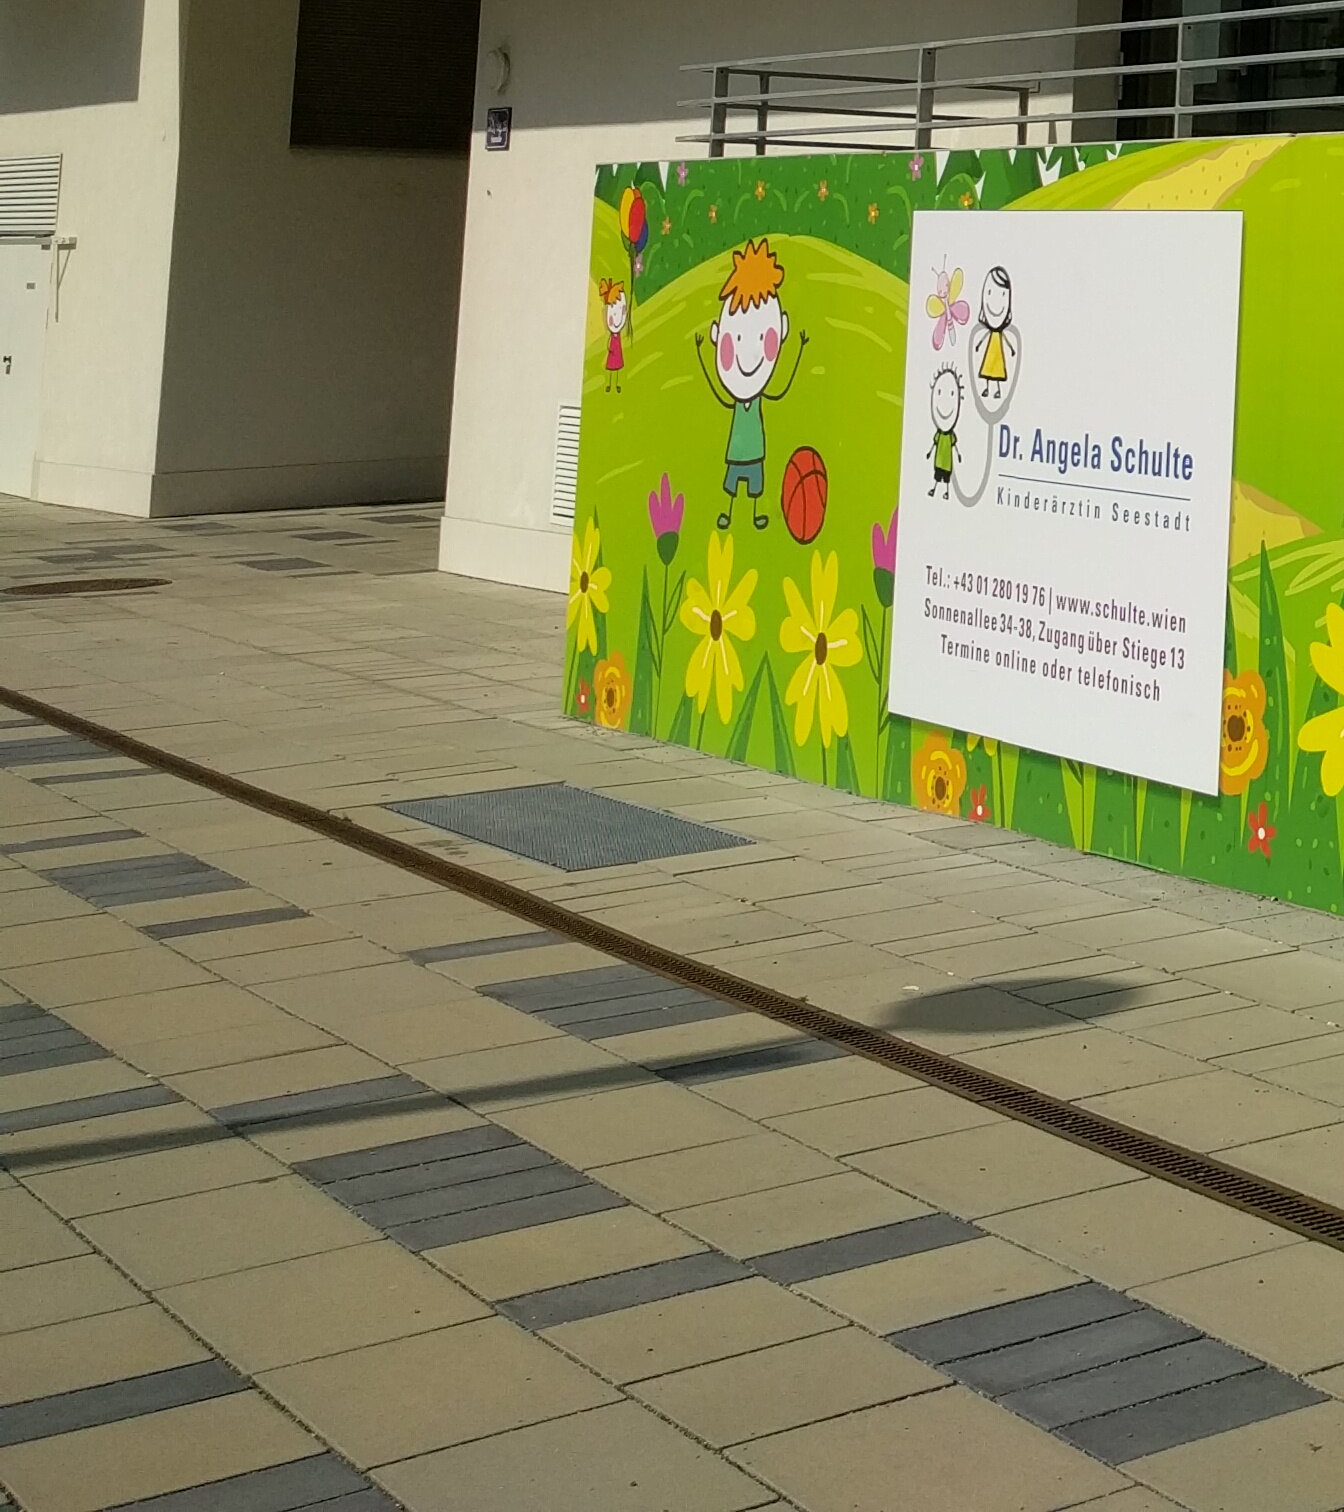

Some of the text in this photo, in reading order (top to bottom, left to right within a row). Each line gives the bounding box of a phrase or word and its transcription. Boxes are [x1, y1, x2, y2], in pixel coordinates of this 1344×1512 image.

[998, 424, 1194, 480] Dr. Angela Schulte
[997, 486, 1190, 532] Kinderärztin Seestadt
[925, 565, 951, 589] Tel.:
[953, 571, 974, 593] +43
[976, 575, 989, 596] 01
[992, 578, 1012, 601] 280
[1016, 582, 1028, 605] 19
[1032, 585, 1046, 607] 76
[1056, 592, 1187, 633] www.schulte.wien
[924, 597, 1185, 670] Sonnenallee 34-38, Zugang über Stiege 13
[940, 634, 1161, 702] Termine online oder telefonisch
